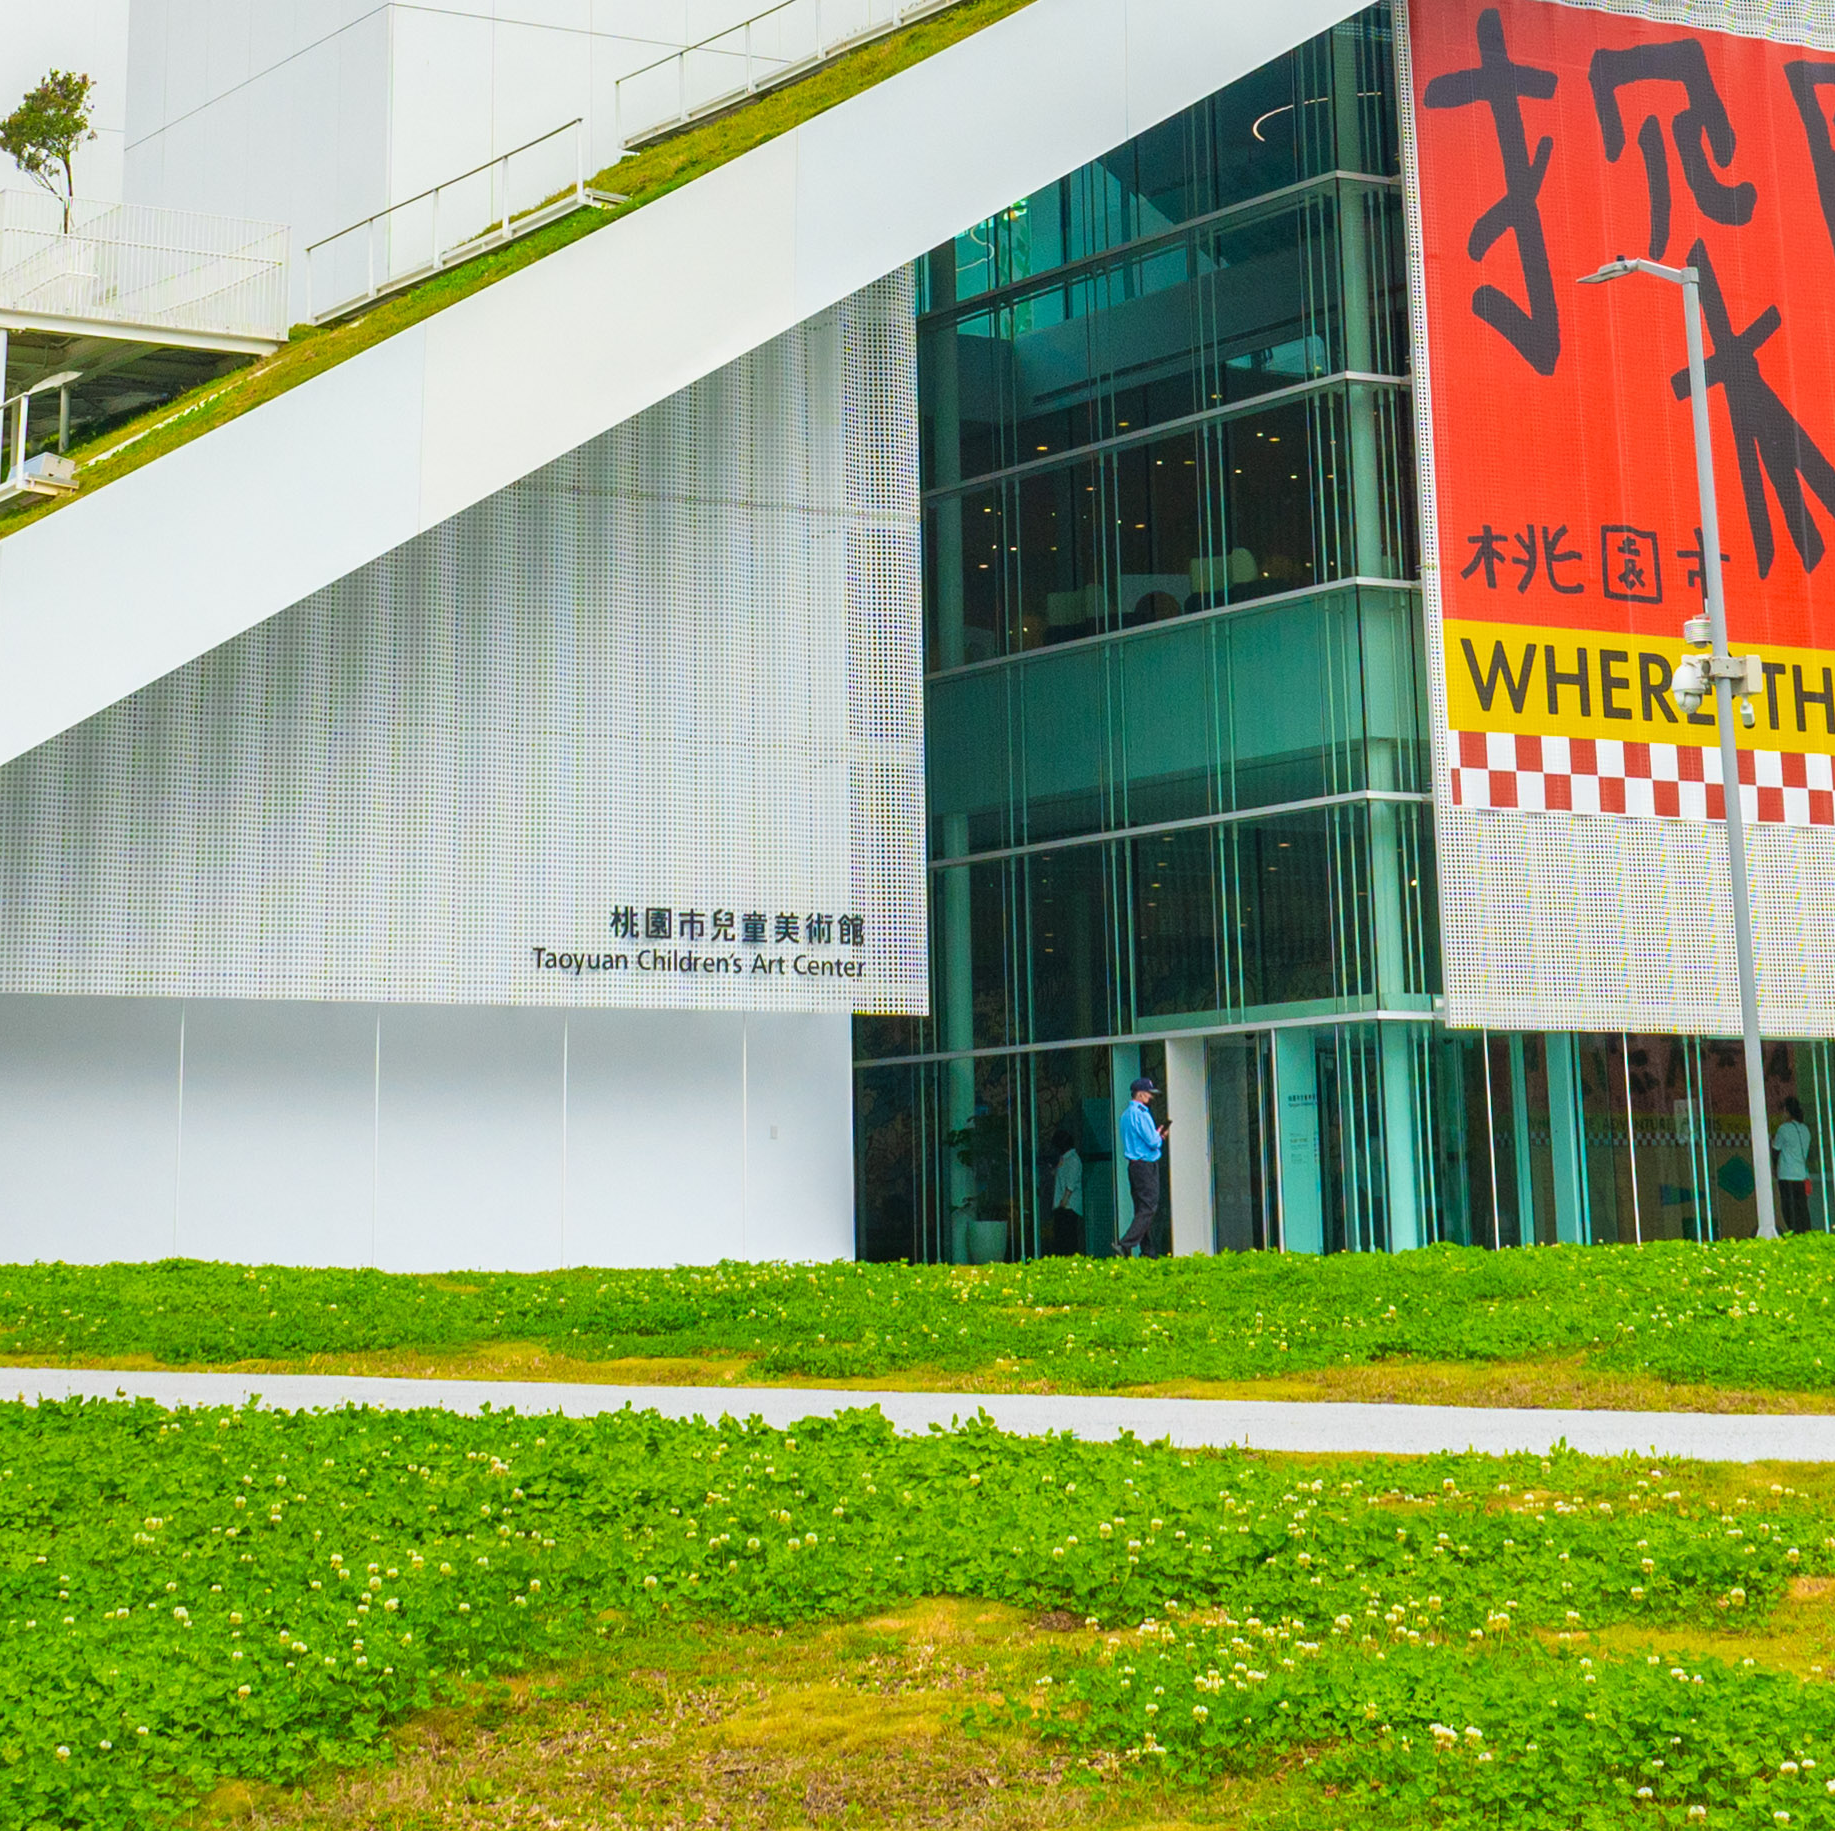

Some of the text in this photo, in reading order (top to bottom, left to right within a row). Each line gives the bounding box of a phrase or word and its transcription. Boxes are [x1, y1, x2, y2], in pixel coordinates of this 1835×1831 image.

[609, 905, 865, 947] 桃園市兒童美術館
[532, 947, 865, 978] Taoyuan Children's Art Center
